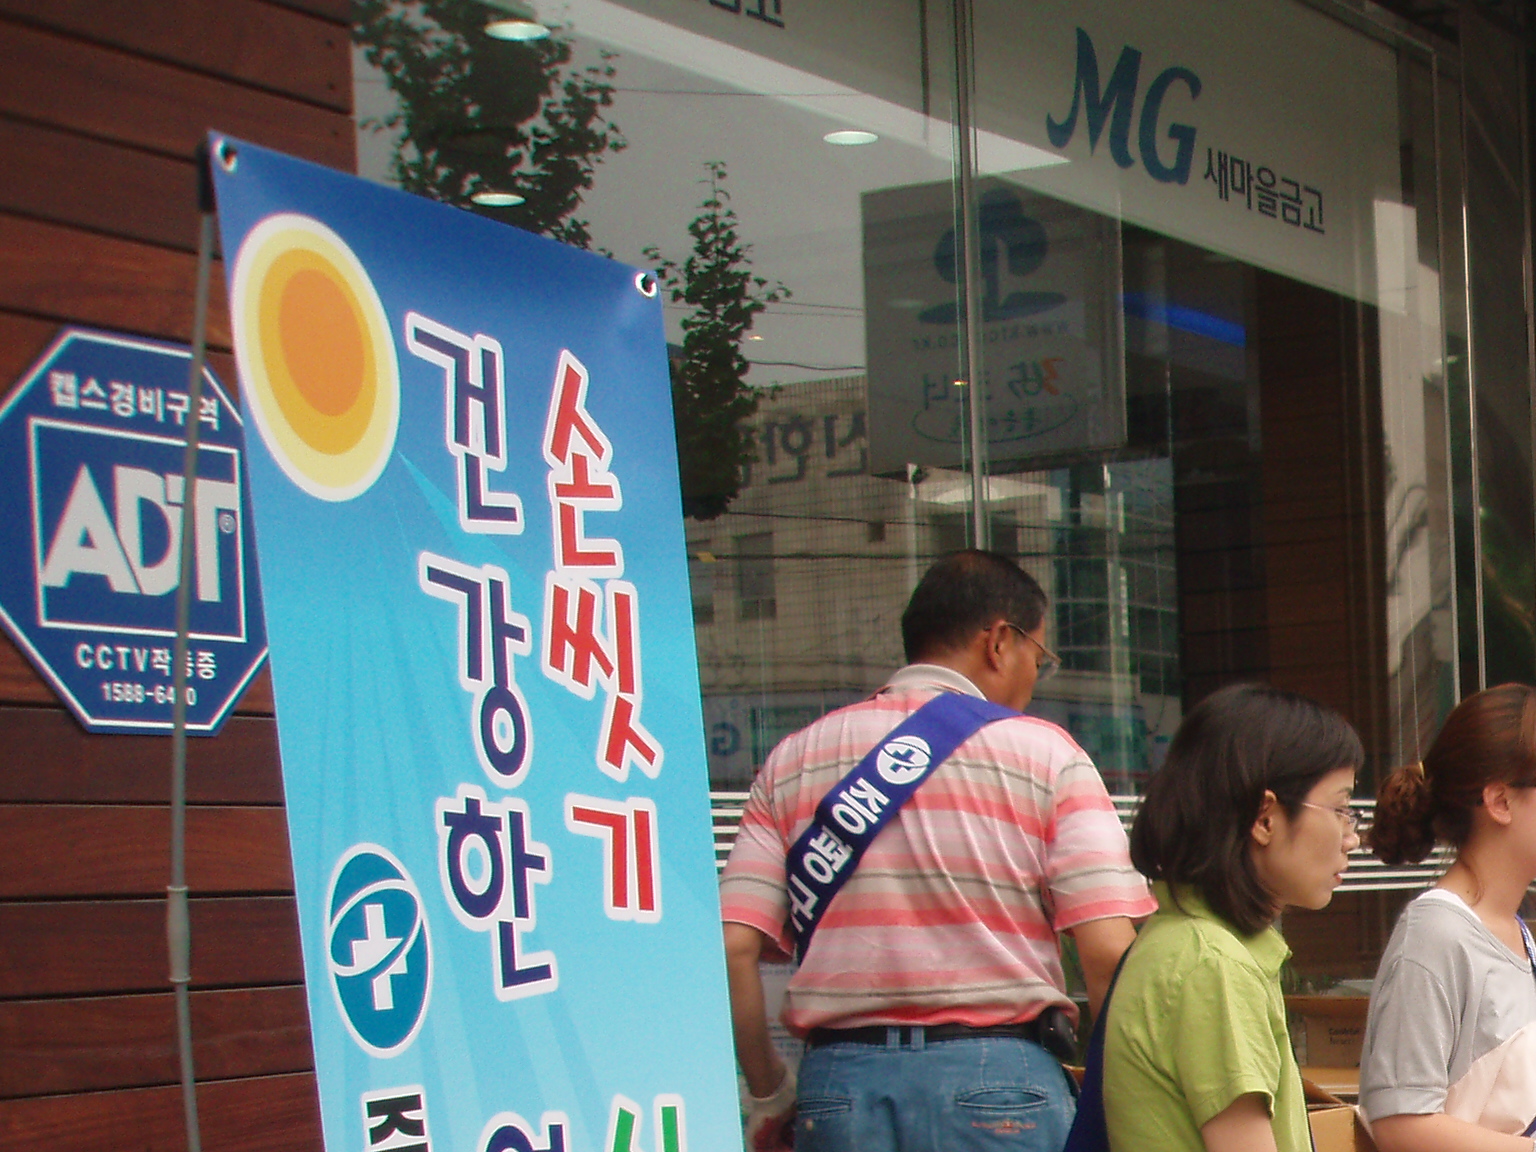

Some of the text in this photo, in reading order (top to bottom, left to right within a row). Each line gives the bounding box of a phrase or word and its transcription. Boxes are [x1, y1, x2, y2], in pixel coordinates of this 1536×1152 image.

[1046, 27, 1202, 186] MG
[1203, 146, 1326, 235] 새마을금고
[48, 370, 220, 431] 캡스경비구역
[41, 463, 240, 603] ADT
[101, 681, 198, 706] 1588-640
[409, 318, 556, 996] 건강한
[547, 352, 660, 918] 손씻기
